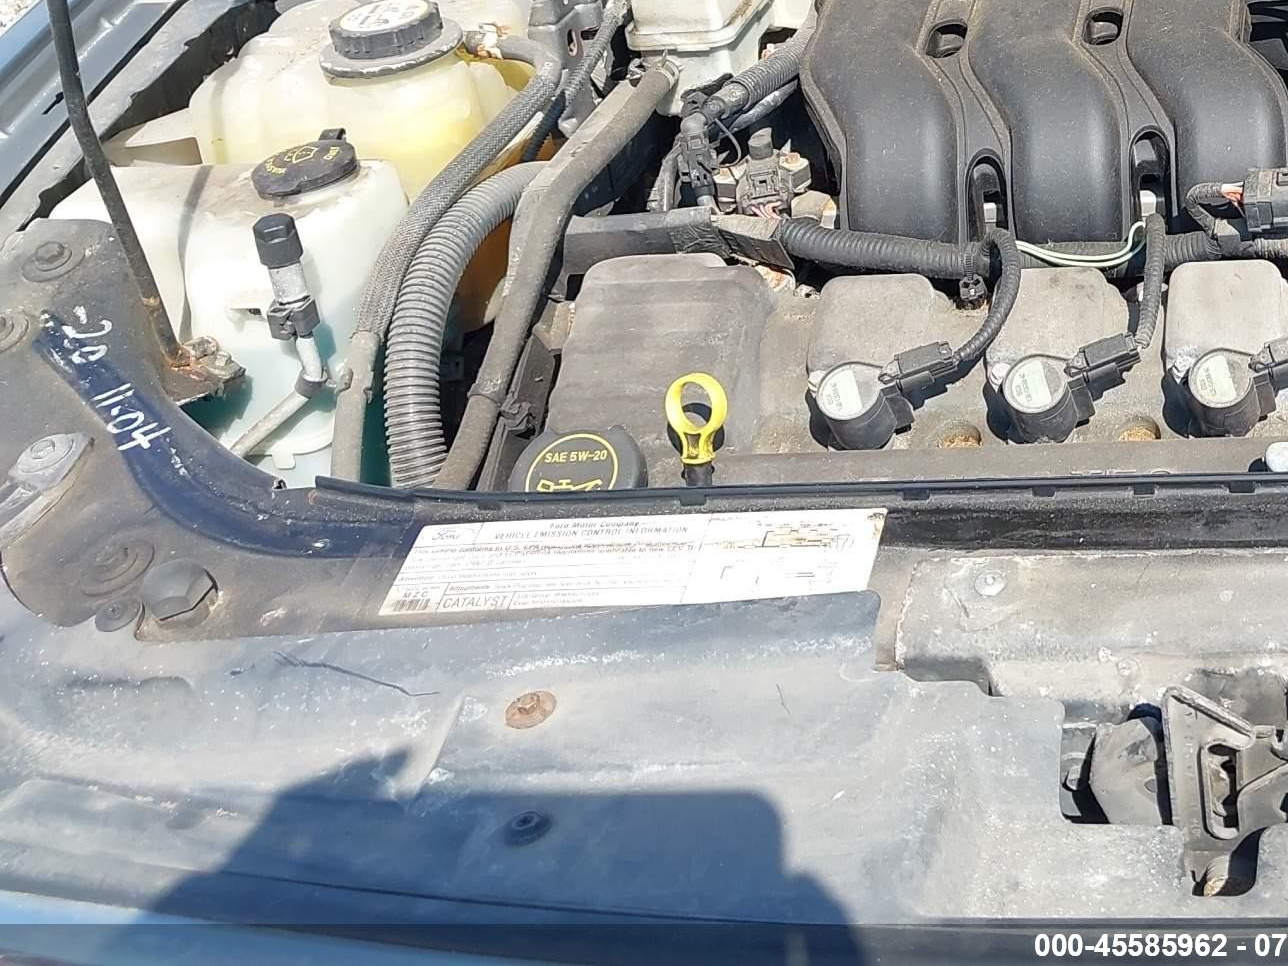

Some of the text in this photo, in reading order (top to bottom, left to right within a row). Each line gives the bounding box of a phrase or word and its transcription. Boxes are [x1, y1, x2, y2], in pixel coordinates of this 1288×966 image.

[544, 449, 608, 463] SAE 5W-20
[495, 527, 688, 540] VEHICLE EMISSION CONTROL INFORMATION
[443, 595, 508, 609] CATALYST
